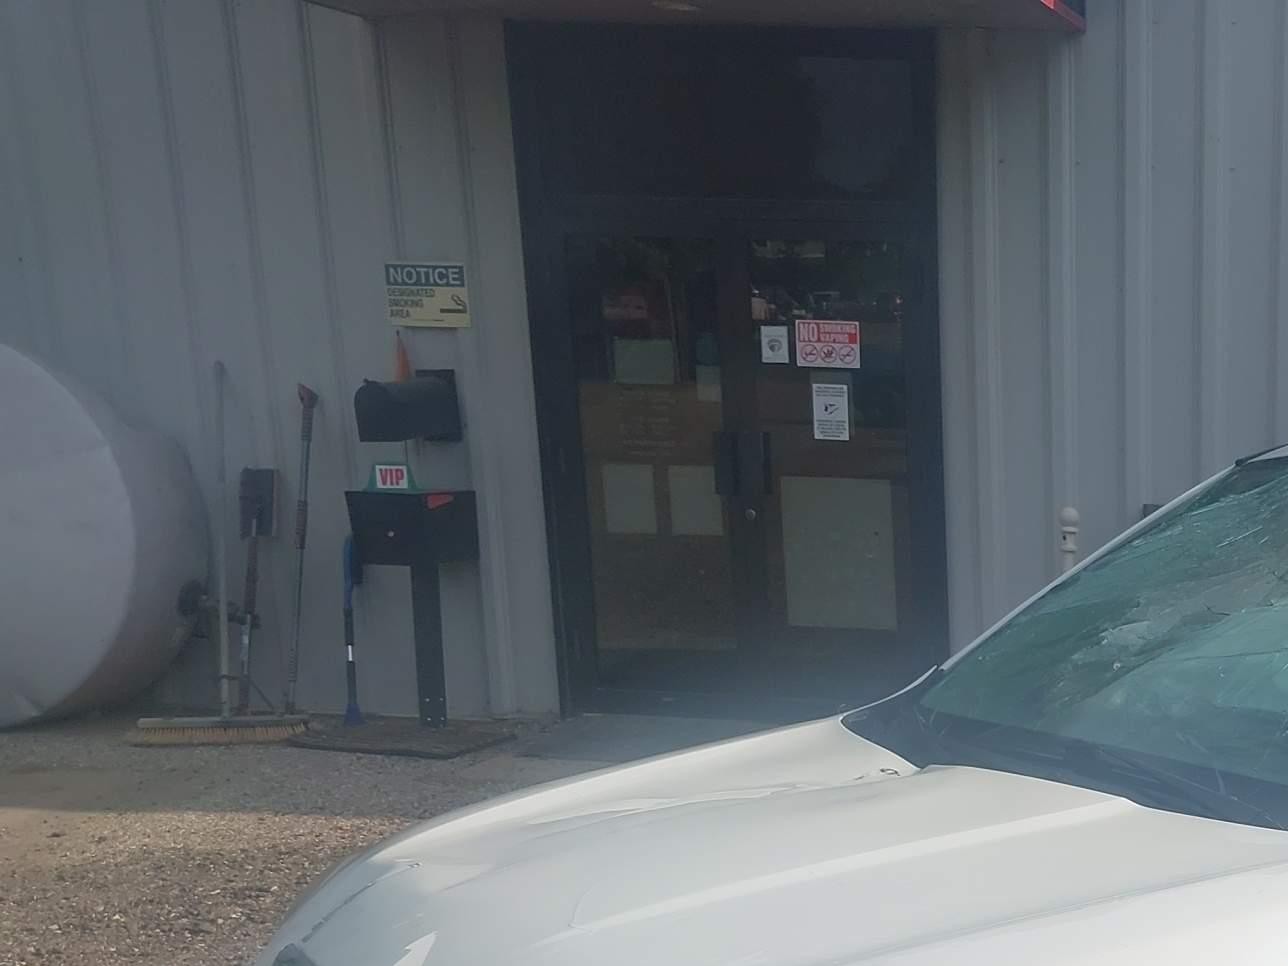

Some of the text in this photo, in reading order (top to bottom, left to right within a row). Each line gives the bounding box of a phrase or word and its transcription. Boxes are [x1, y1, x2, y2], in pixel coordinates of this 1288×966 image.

[388, 266, 461, 285] NOTICE
[387, 288, 435, 297] DESIGNATED
[388, 298, 424, 307] SMOKING
[390, 308, 411, 318] AREA
[799, 323, 818, 342] NO
[379, 468, 405, 486] VIP
